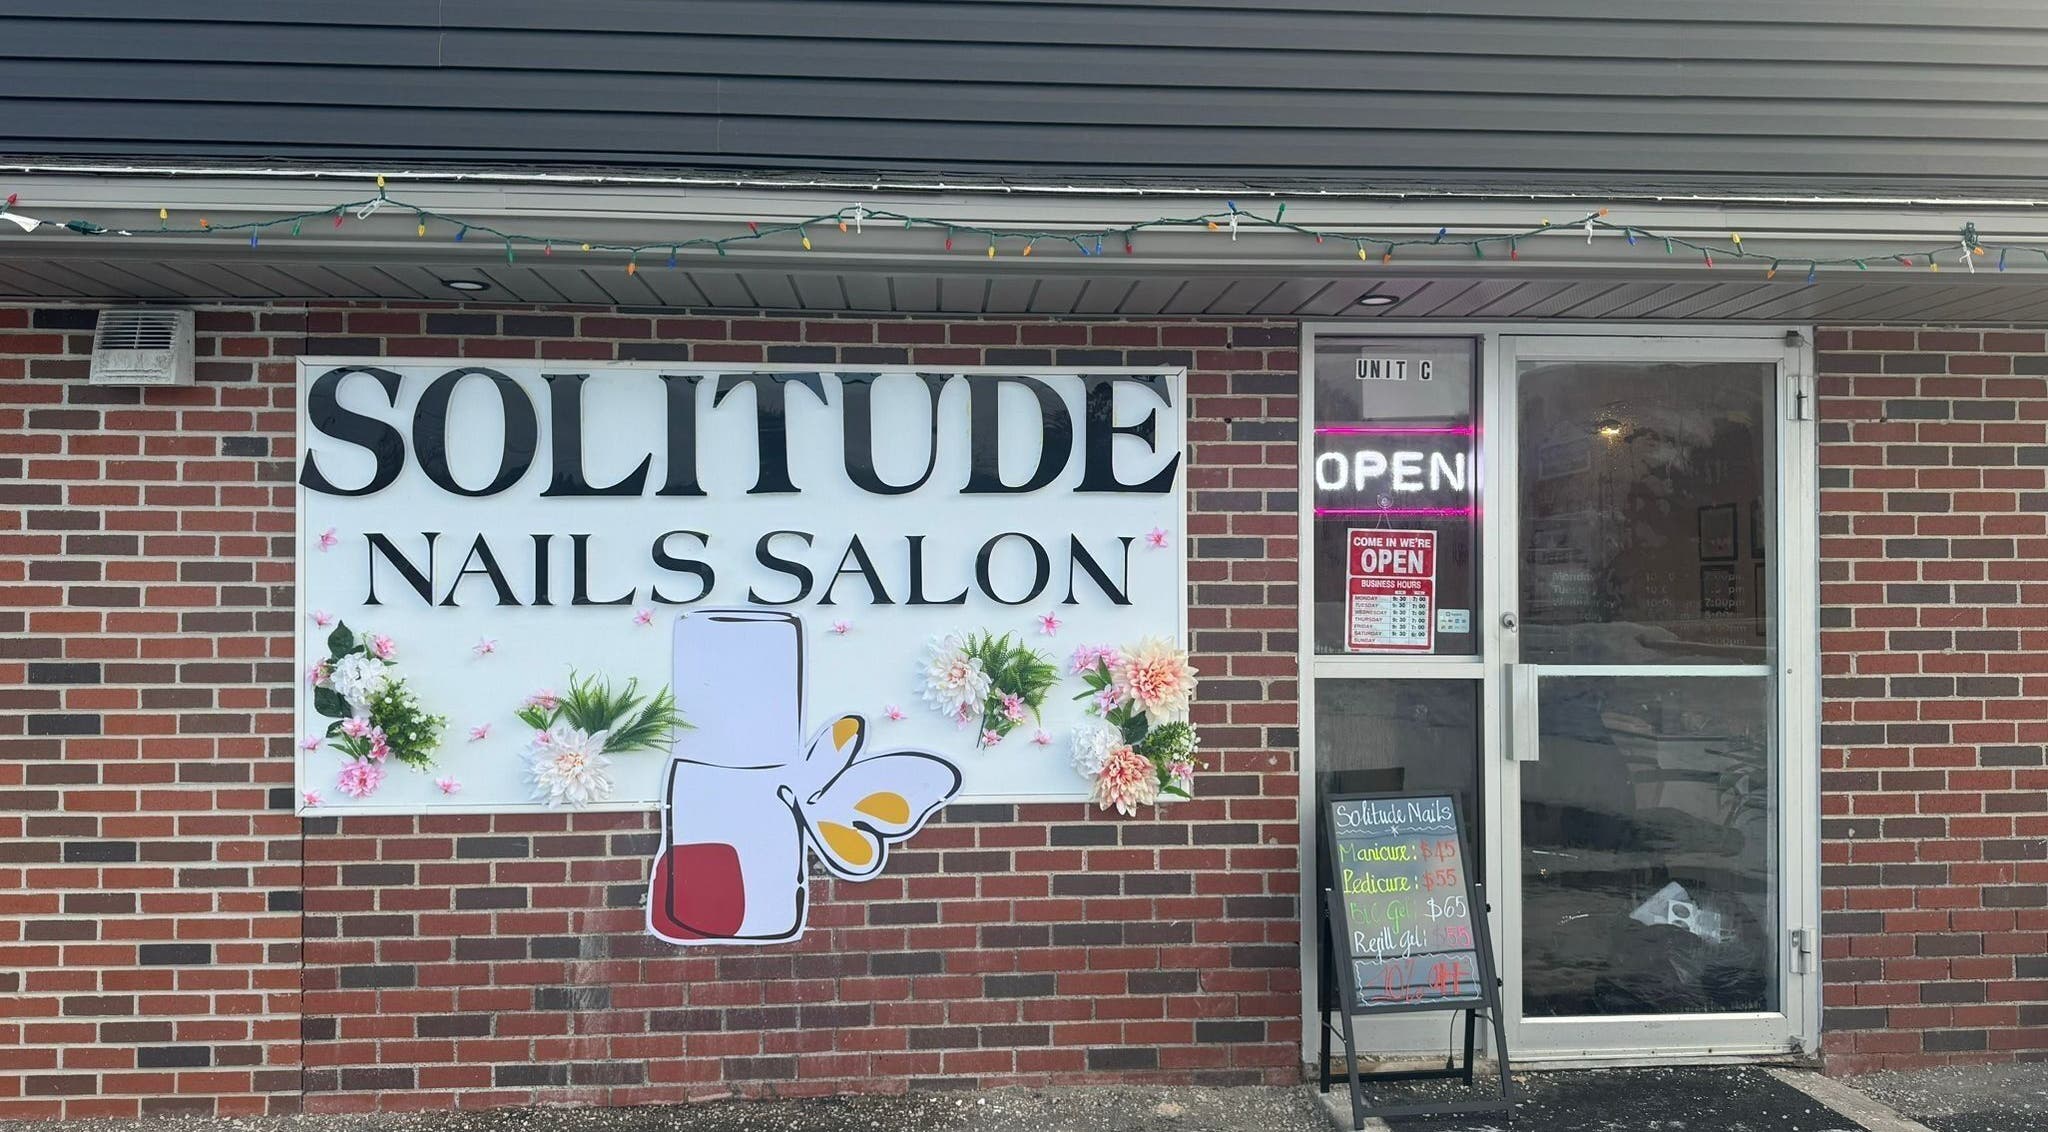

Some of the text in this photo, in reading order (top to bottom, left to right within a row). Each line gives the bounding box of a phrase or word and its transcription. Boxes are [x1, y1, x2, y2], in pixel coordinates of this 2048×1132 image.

[1358, 359, 1431, 380] UNIT C
[299, 365, 1181, 498] SOLITUDE
[1315, 450, 1466, 491] OPEN
[1353, 536, 1432, 548] COME IN WE'RE
[362, 529, 1137, 607] NAILS SALON
[1361, 548, 1425, 574] OPEN
[1361, 580, 1421, 589] BUSINESS HOURS
[1336, 799, 1452, 828] Solitude Nails
[1420, 840, 1455, 863] $45
[1423, 867, 1457, 893] $55
[1424, 895, 1467, 923] $65
[1354, 925, 1396, 965] Refill
